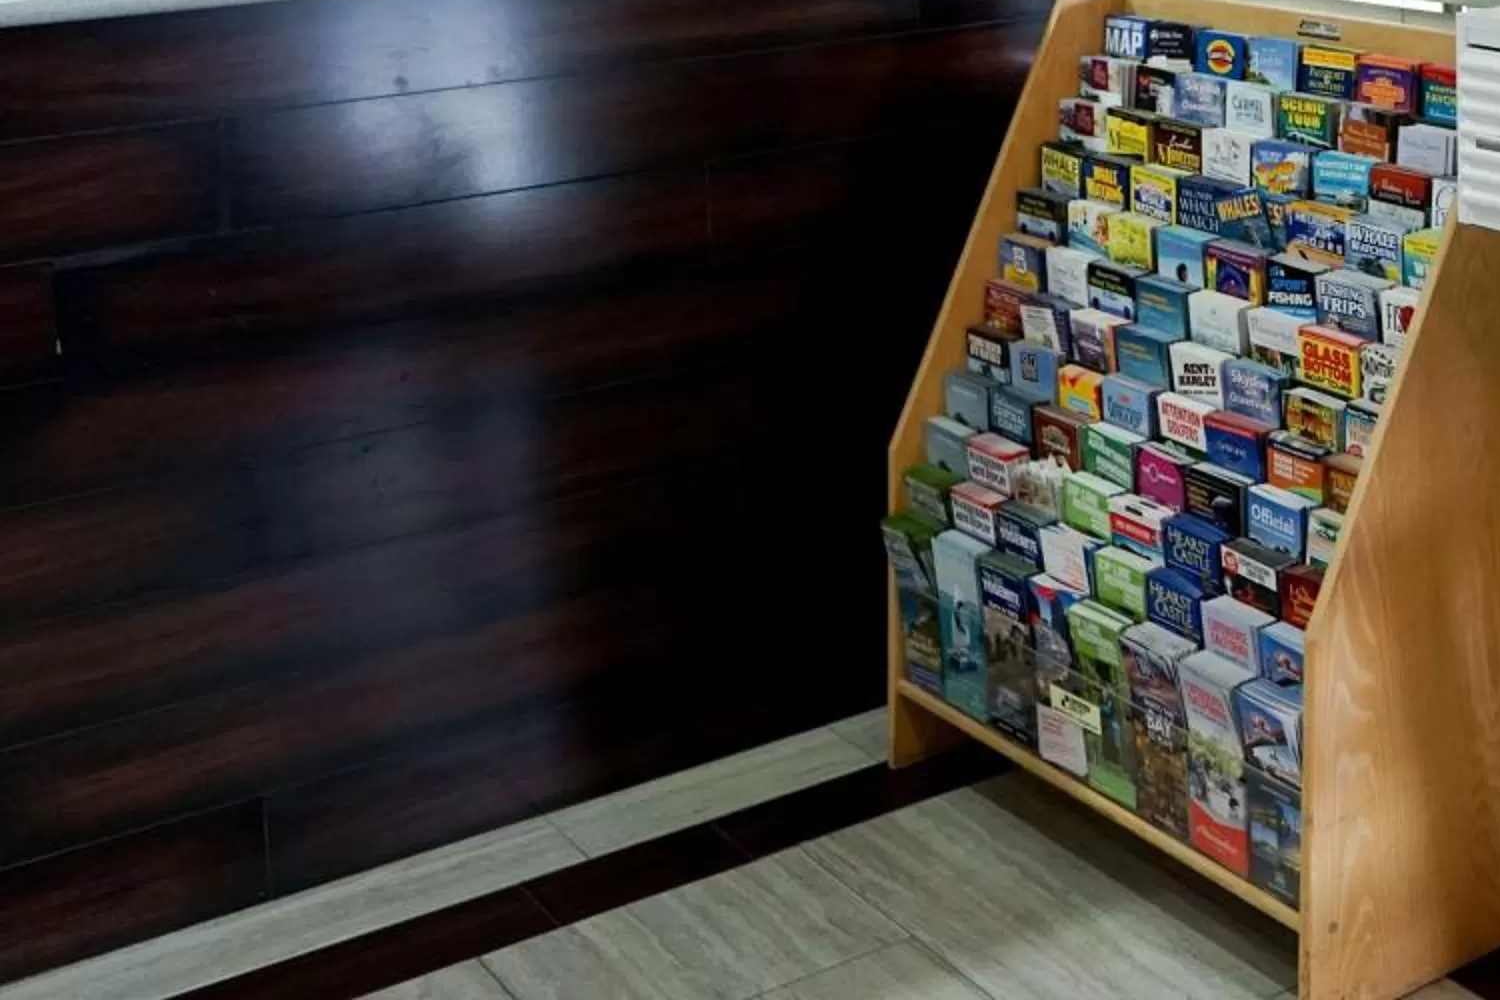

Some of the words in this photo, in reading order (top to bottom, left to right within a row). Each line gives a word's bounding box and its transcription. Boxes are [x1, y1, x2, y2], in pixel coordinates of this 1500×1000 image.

[1105, 27, 1144, 58] MAP
[1281, 98, 1325, 115] SCENIC
[1287, 112, 1321, 129] TOUR
[1180, 213, 1219, 233] WATCH
[1350, 224, 1398, 250] WHALE
[1268, 291, 1313, 307] FISHING
[1321, 296, 1366, 319] TRIPS
[1303, 341, 1350, 368] GLASS
[1178, 375, 1217, 388] HARLEY
[1183, 363, 1209, 375] RENT
[1303, 356, 1352, 385] BOTTOM
[1251, 504, 1295, 535] Official
[1166, 523, 1210, 550] HEARST
[1173, 543, 1210, 572] CASTLE
[1148, 577, 1192, 605] HEARST
[1154, 598, 1192, 625] CASTLE
